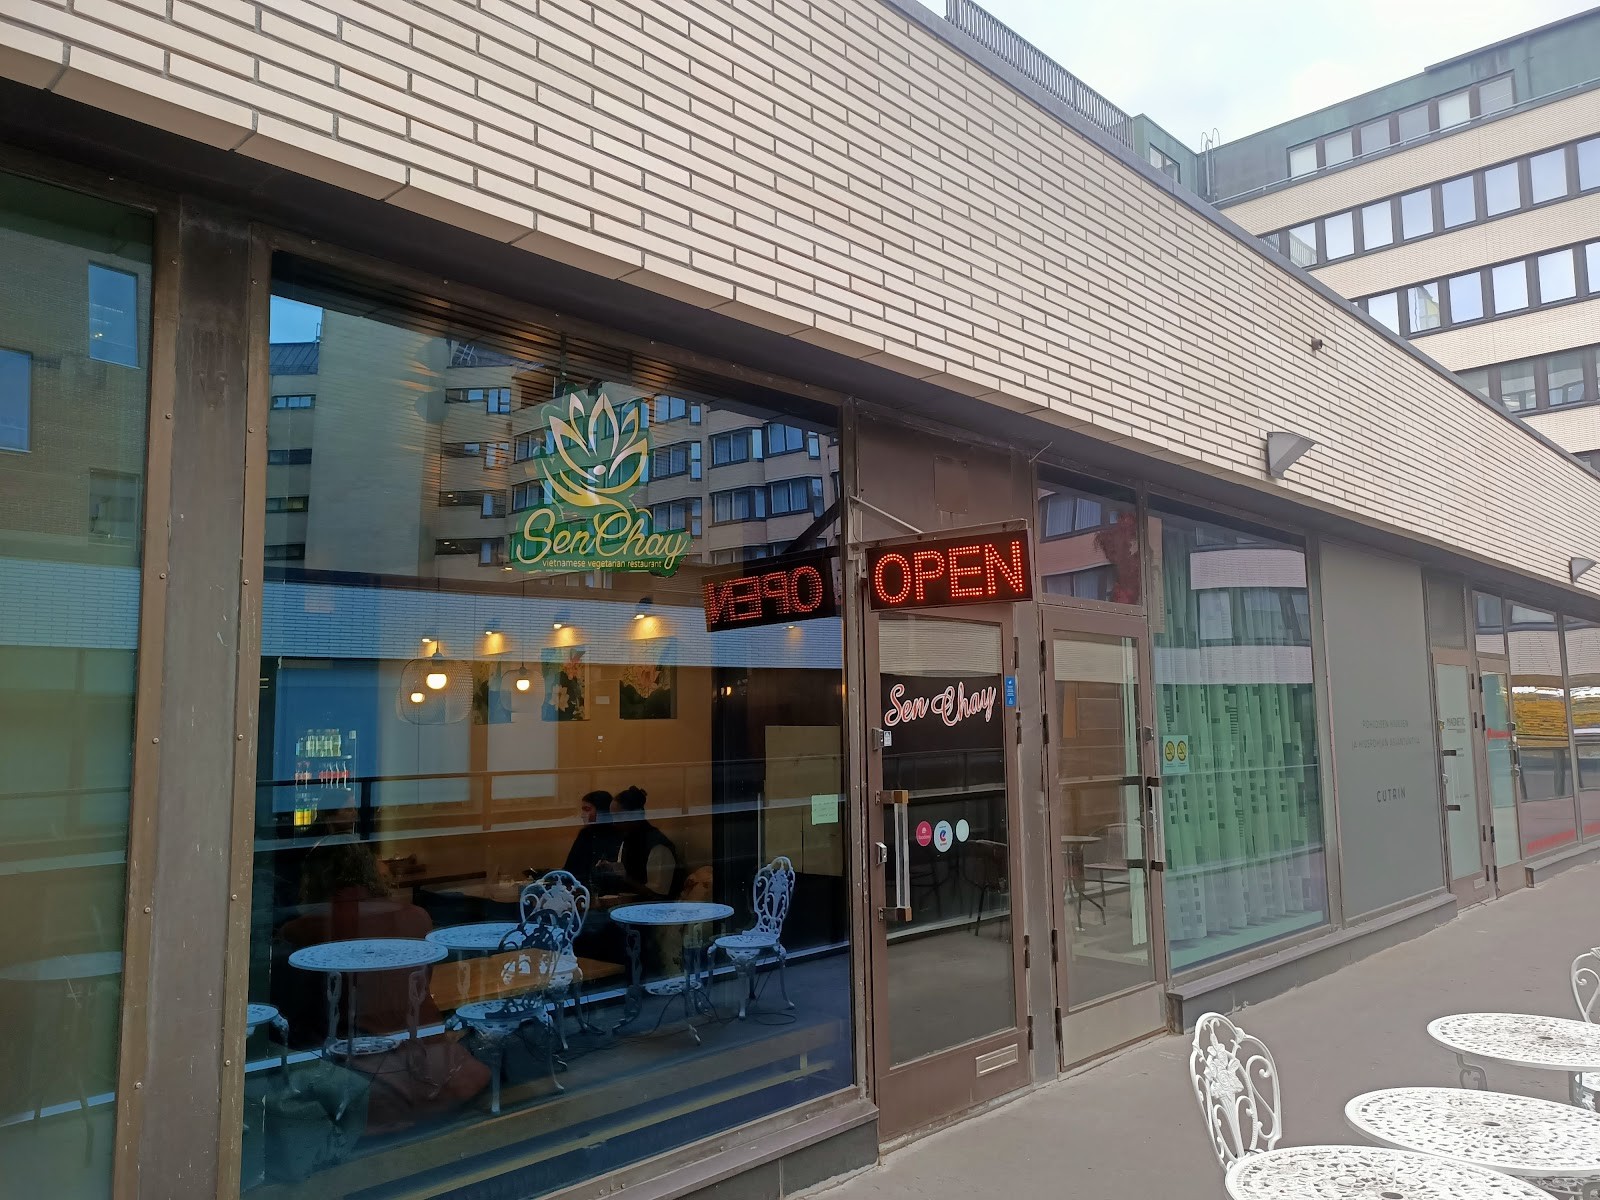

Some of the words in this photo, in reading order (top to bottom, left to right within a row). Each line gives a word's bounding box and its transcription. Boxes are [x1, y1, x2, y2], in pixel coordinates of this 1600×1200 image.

[516, 508, 594, 565] Sen
[594, 510, 688, 570] Chay
[542, 559, 586, 568] vietnamese
[587, 560, 626, 570] vegetarian
[627, 560, 662, 568] restaurant
[874, 540, 1024, 603] OPEN
[884, 683, 930, 727] Sen
[931, 681, 997, 727] Chay
[1376, 786, 1406, 804] CUTRIN
